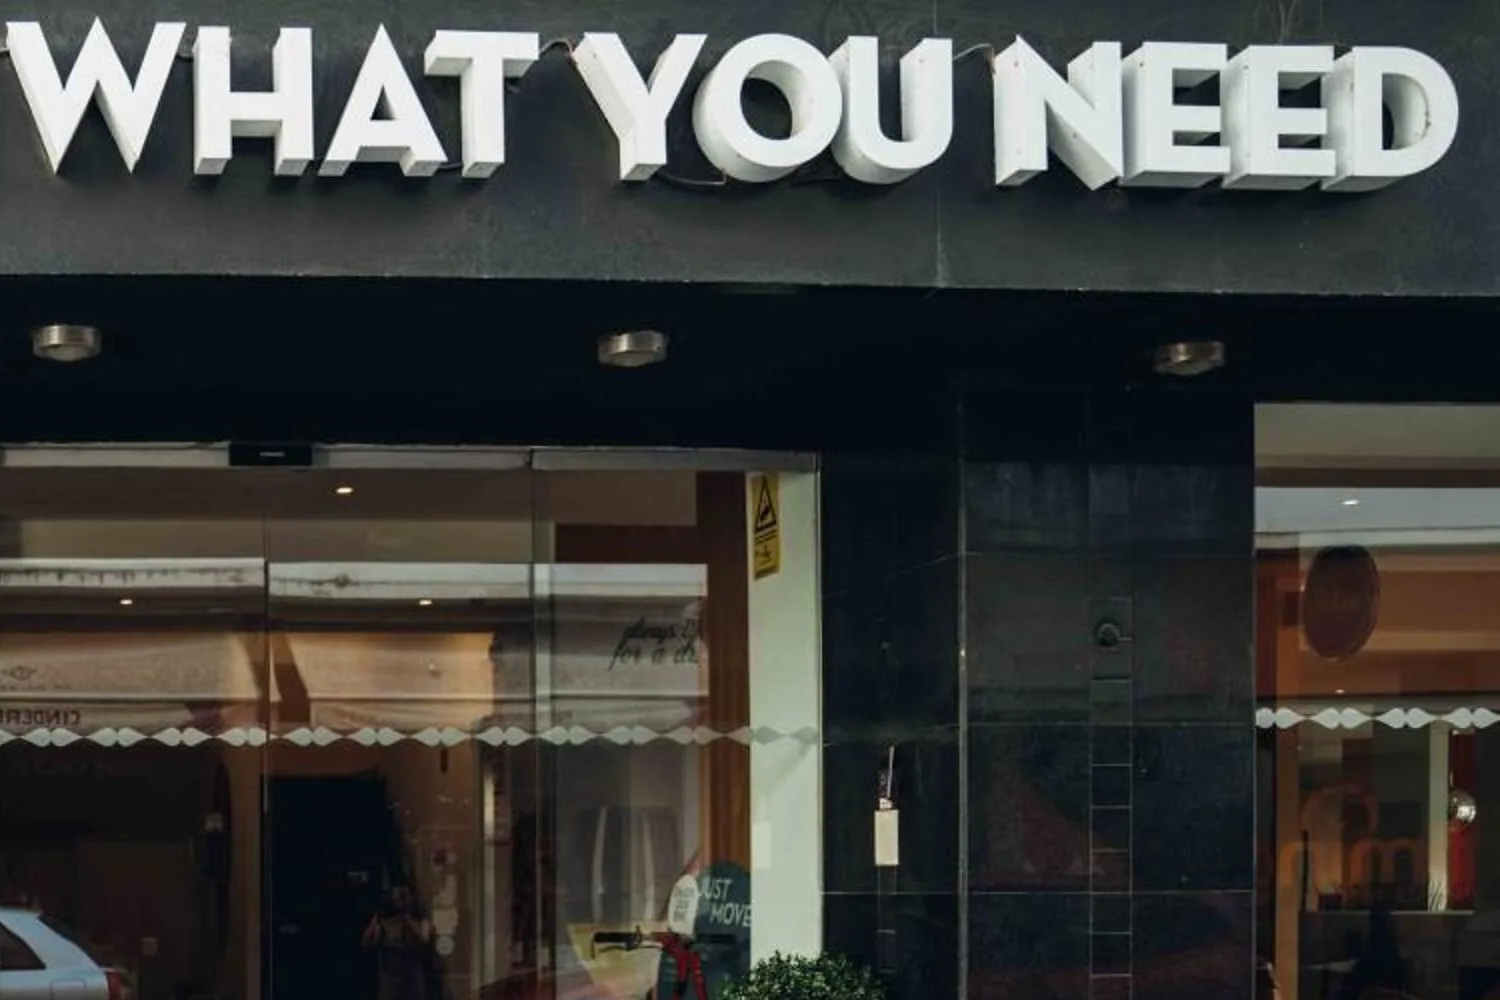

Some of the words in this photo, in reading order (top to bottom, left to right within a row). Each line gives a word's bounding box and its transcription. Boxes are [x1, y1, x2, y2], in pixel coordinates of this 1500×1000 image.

[5, 16, 540, 179] WHAT
[571, 32, 954, 184] YOU
[993, 34, 1460, 190] NEED
